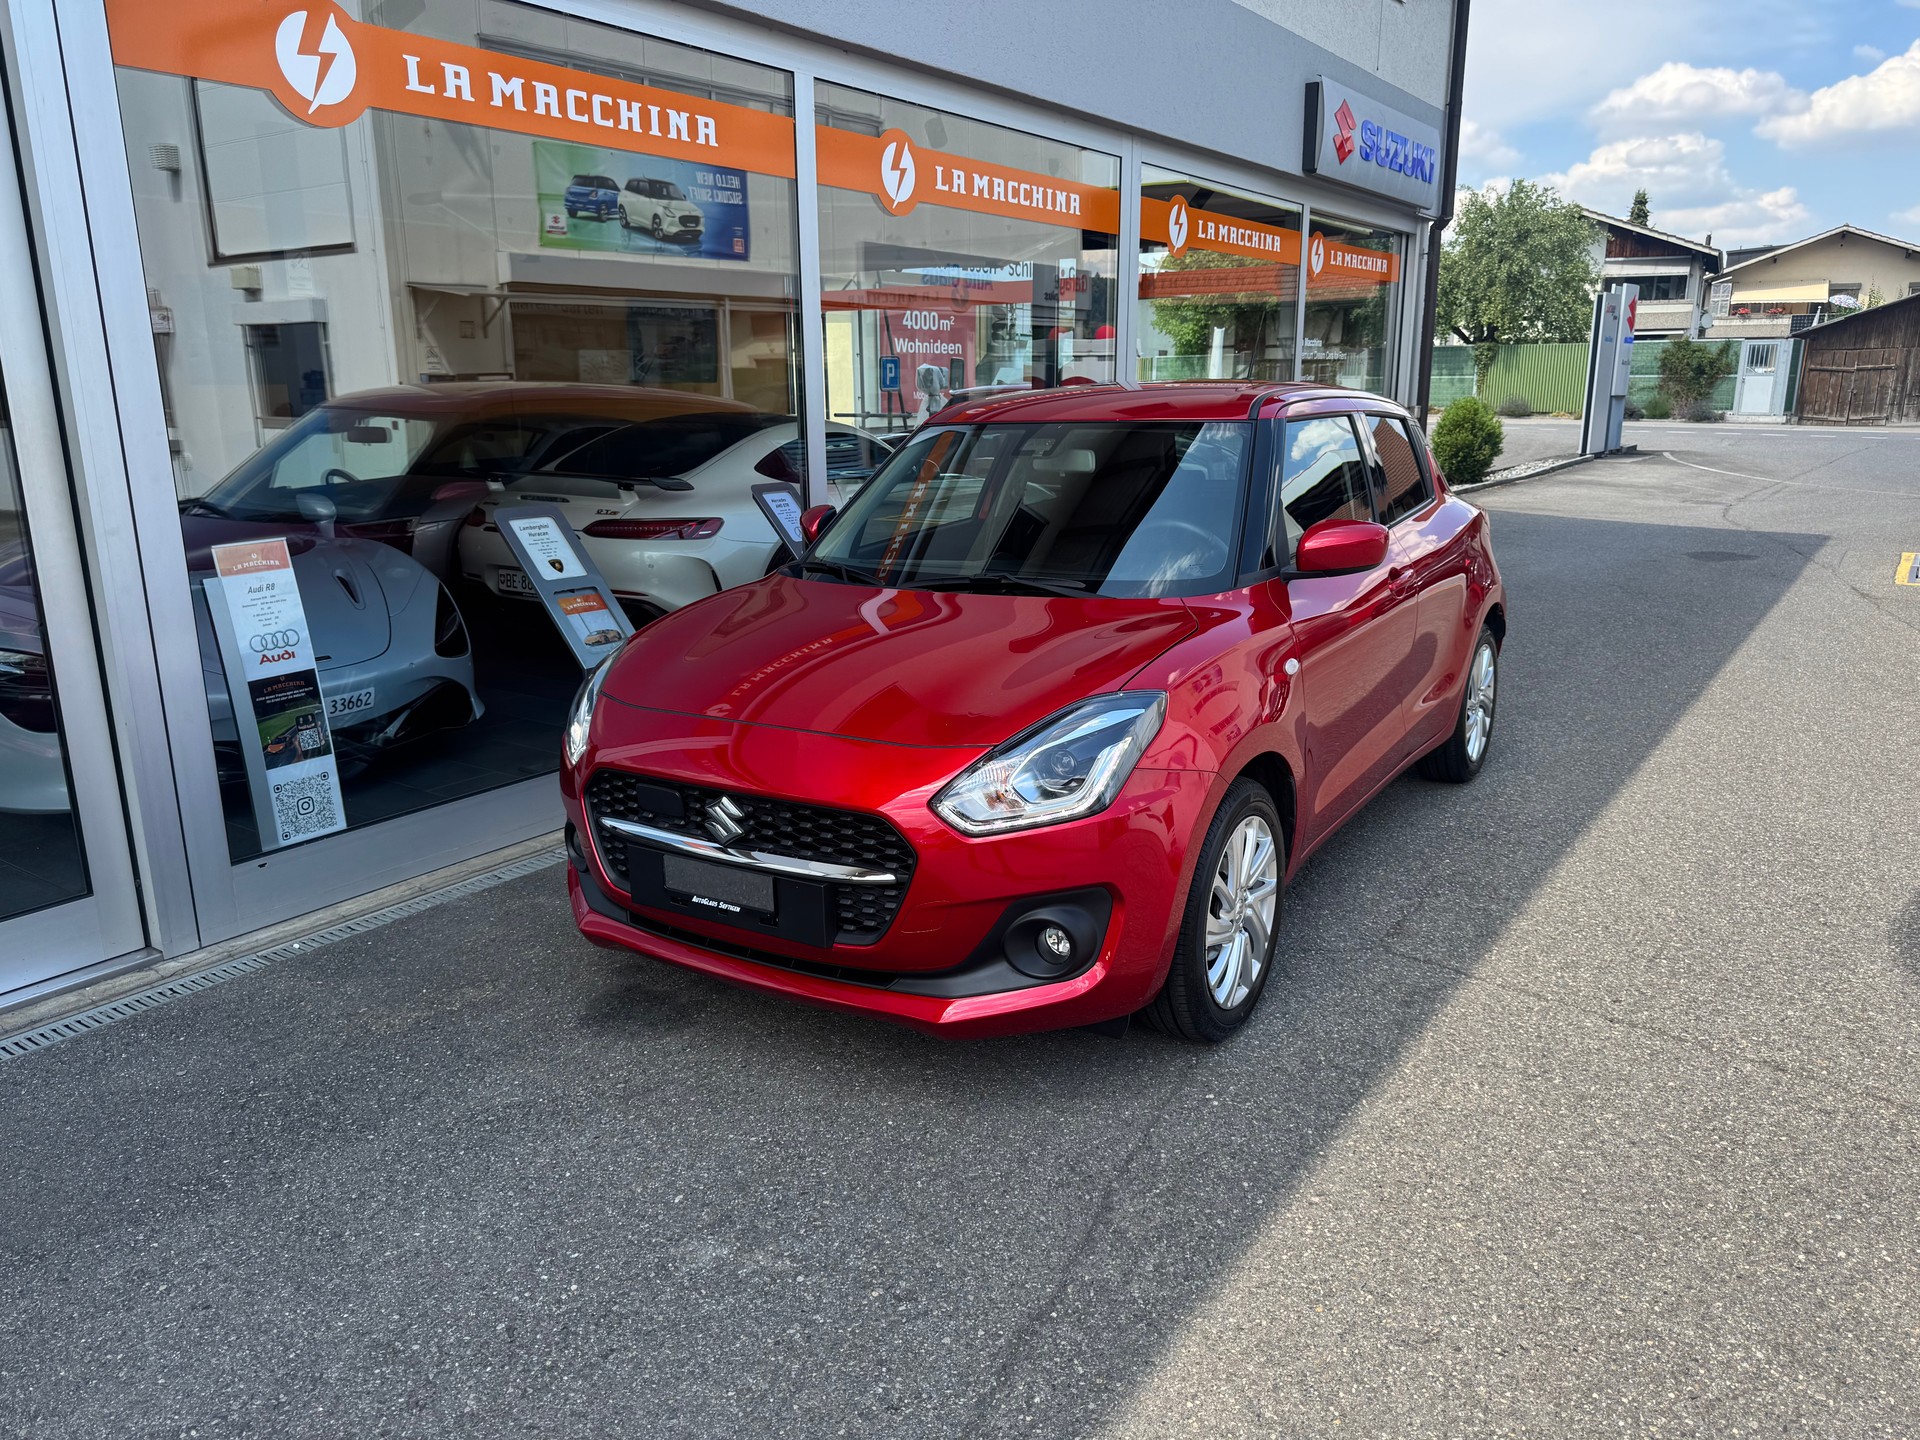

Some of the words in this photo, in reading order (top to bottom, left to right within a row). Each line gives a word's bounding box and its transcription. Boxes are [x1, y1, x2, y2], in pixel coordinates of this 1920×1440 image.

[402, 54, 475, 102] LA
[487, 72, 719, 147] MACCHINA
[1360, 119, 1436, 184] SUZUKI
[935, 165, 966, 194] LA
[972, 173, 1081, 215] MACCHINA
[1197, 219, 1216, 240] LA
[1218, 223, 1281, 252] MACCHINA
[1330, 250, 1343, 265] LA
[1343, 253, 1388, 273] MACCHINA
[894, 337, 962, 355] Wohnideen
[886, 362, 895, 384] P
[243, 560, 281, 568] MACCHINA
[247, 583, 264, 594] Audi
[265, 582, 276, 591] R8
[259, 650, 296, 665] Audi
[330, 691, 372, 715] 33662
